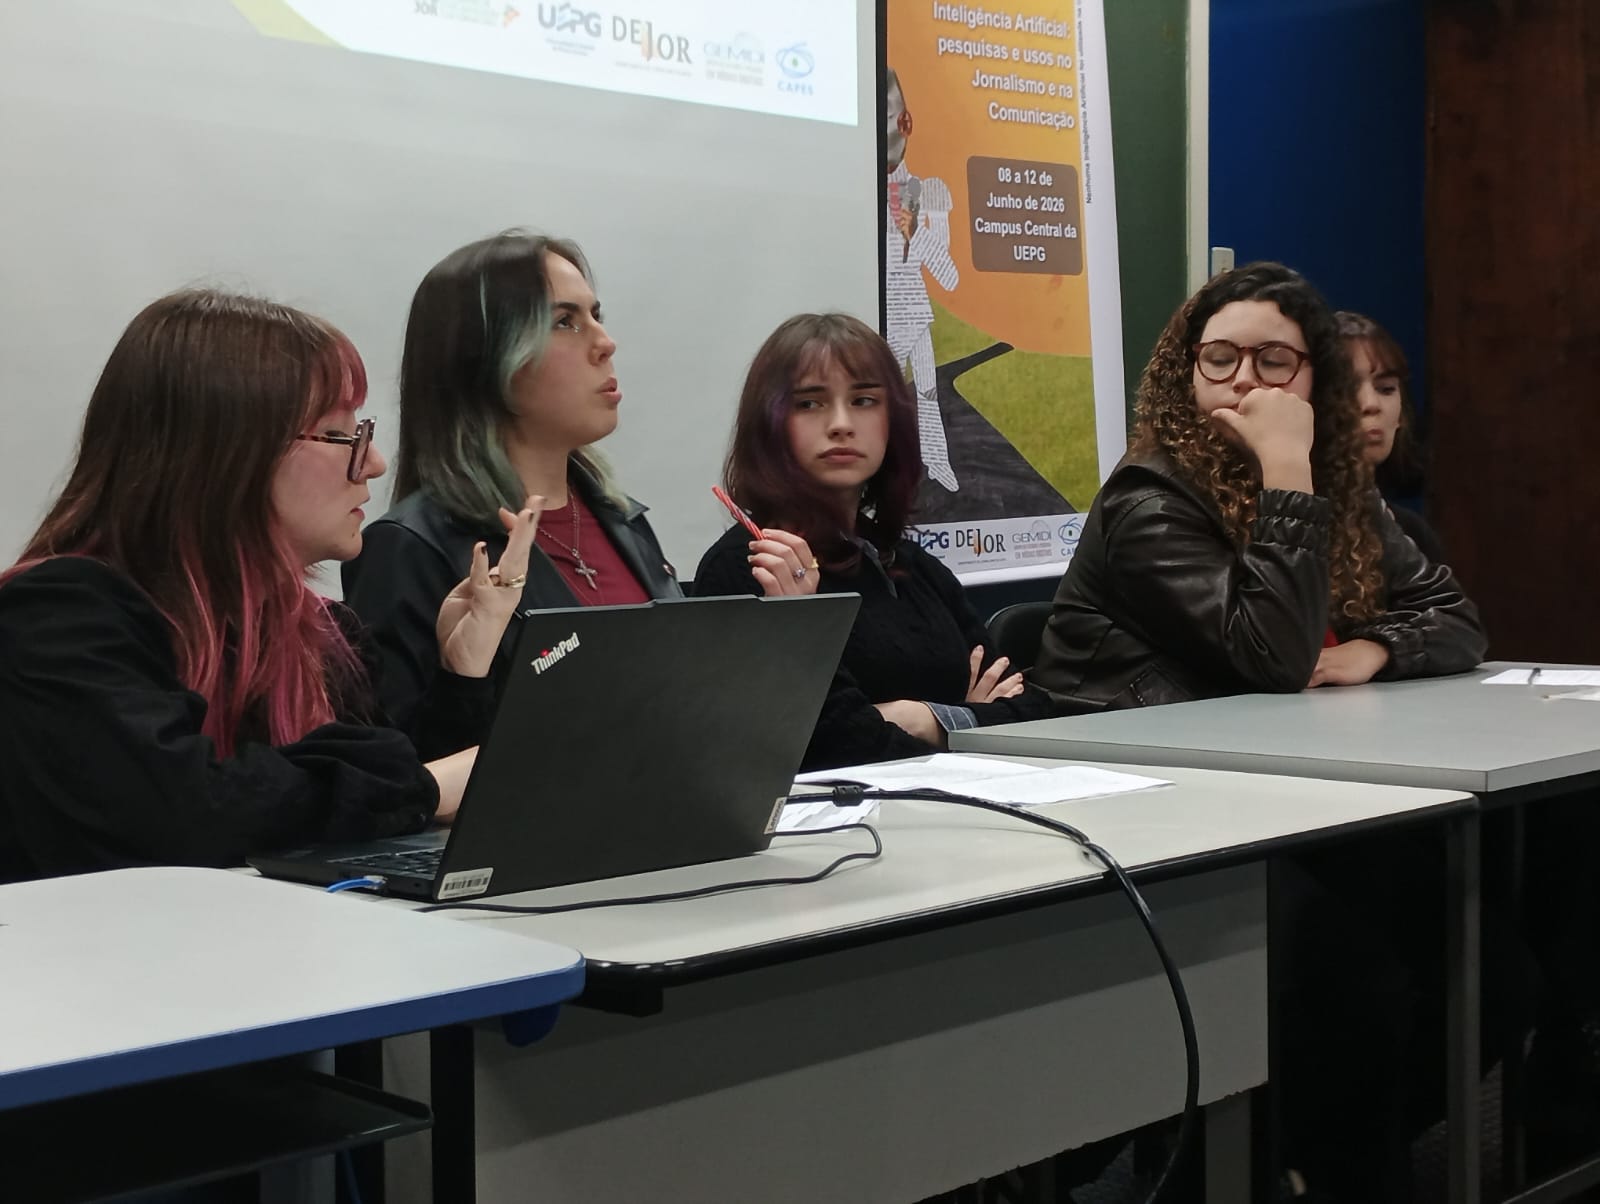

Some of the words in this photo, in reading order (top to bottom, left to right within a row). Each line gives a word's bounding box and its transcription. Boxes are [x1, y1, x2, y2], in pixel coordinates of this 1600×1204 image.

[933, 1, 1012, 29] Inteligência
[1015, 14, 1071, 38] Artificial:
[938, 37, 1009, 60] pesquisas
[1012, 47, 1020, 61] e
[1023, 50, 1054, 66] usos
[1057, 55, 1072, 69] no
[972, 69, 1046, 95] Jornalismo
[1048, 83, 1056, 96] e
[1059, 85, 1073, 98] na
[988, 102, 1075, 130] Comunicação
[1082, 111, 1090, 160] Inteligência
[998, 167, 1012, 183] 08
[1014, 173, 1021, 183] a
[1024, 169, 1037, 184] 12
[1039, 171, 1053, 186] de
[986, 192, 1022, 209] Junho
[1024, 195, 1038, 210] de
[1040, 197, 1065, 212] 2026
[975, 217, 1022, 237] Campus
[1024, 220, 1062, 237] Central
[1064, 223, 1078, 238] da
[1013, 245, 1046, 261] UEPG
[531, 631, 580, 675] ThinkPad
